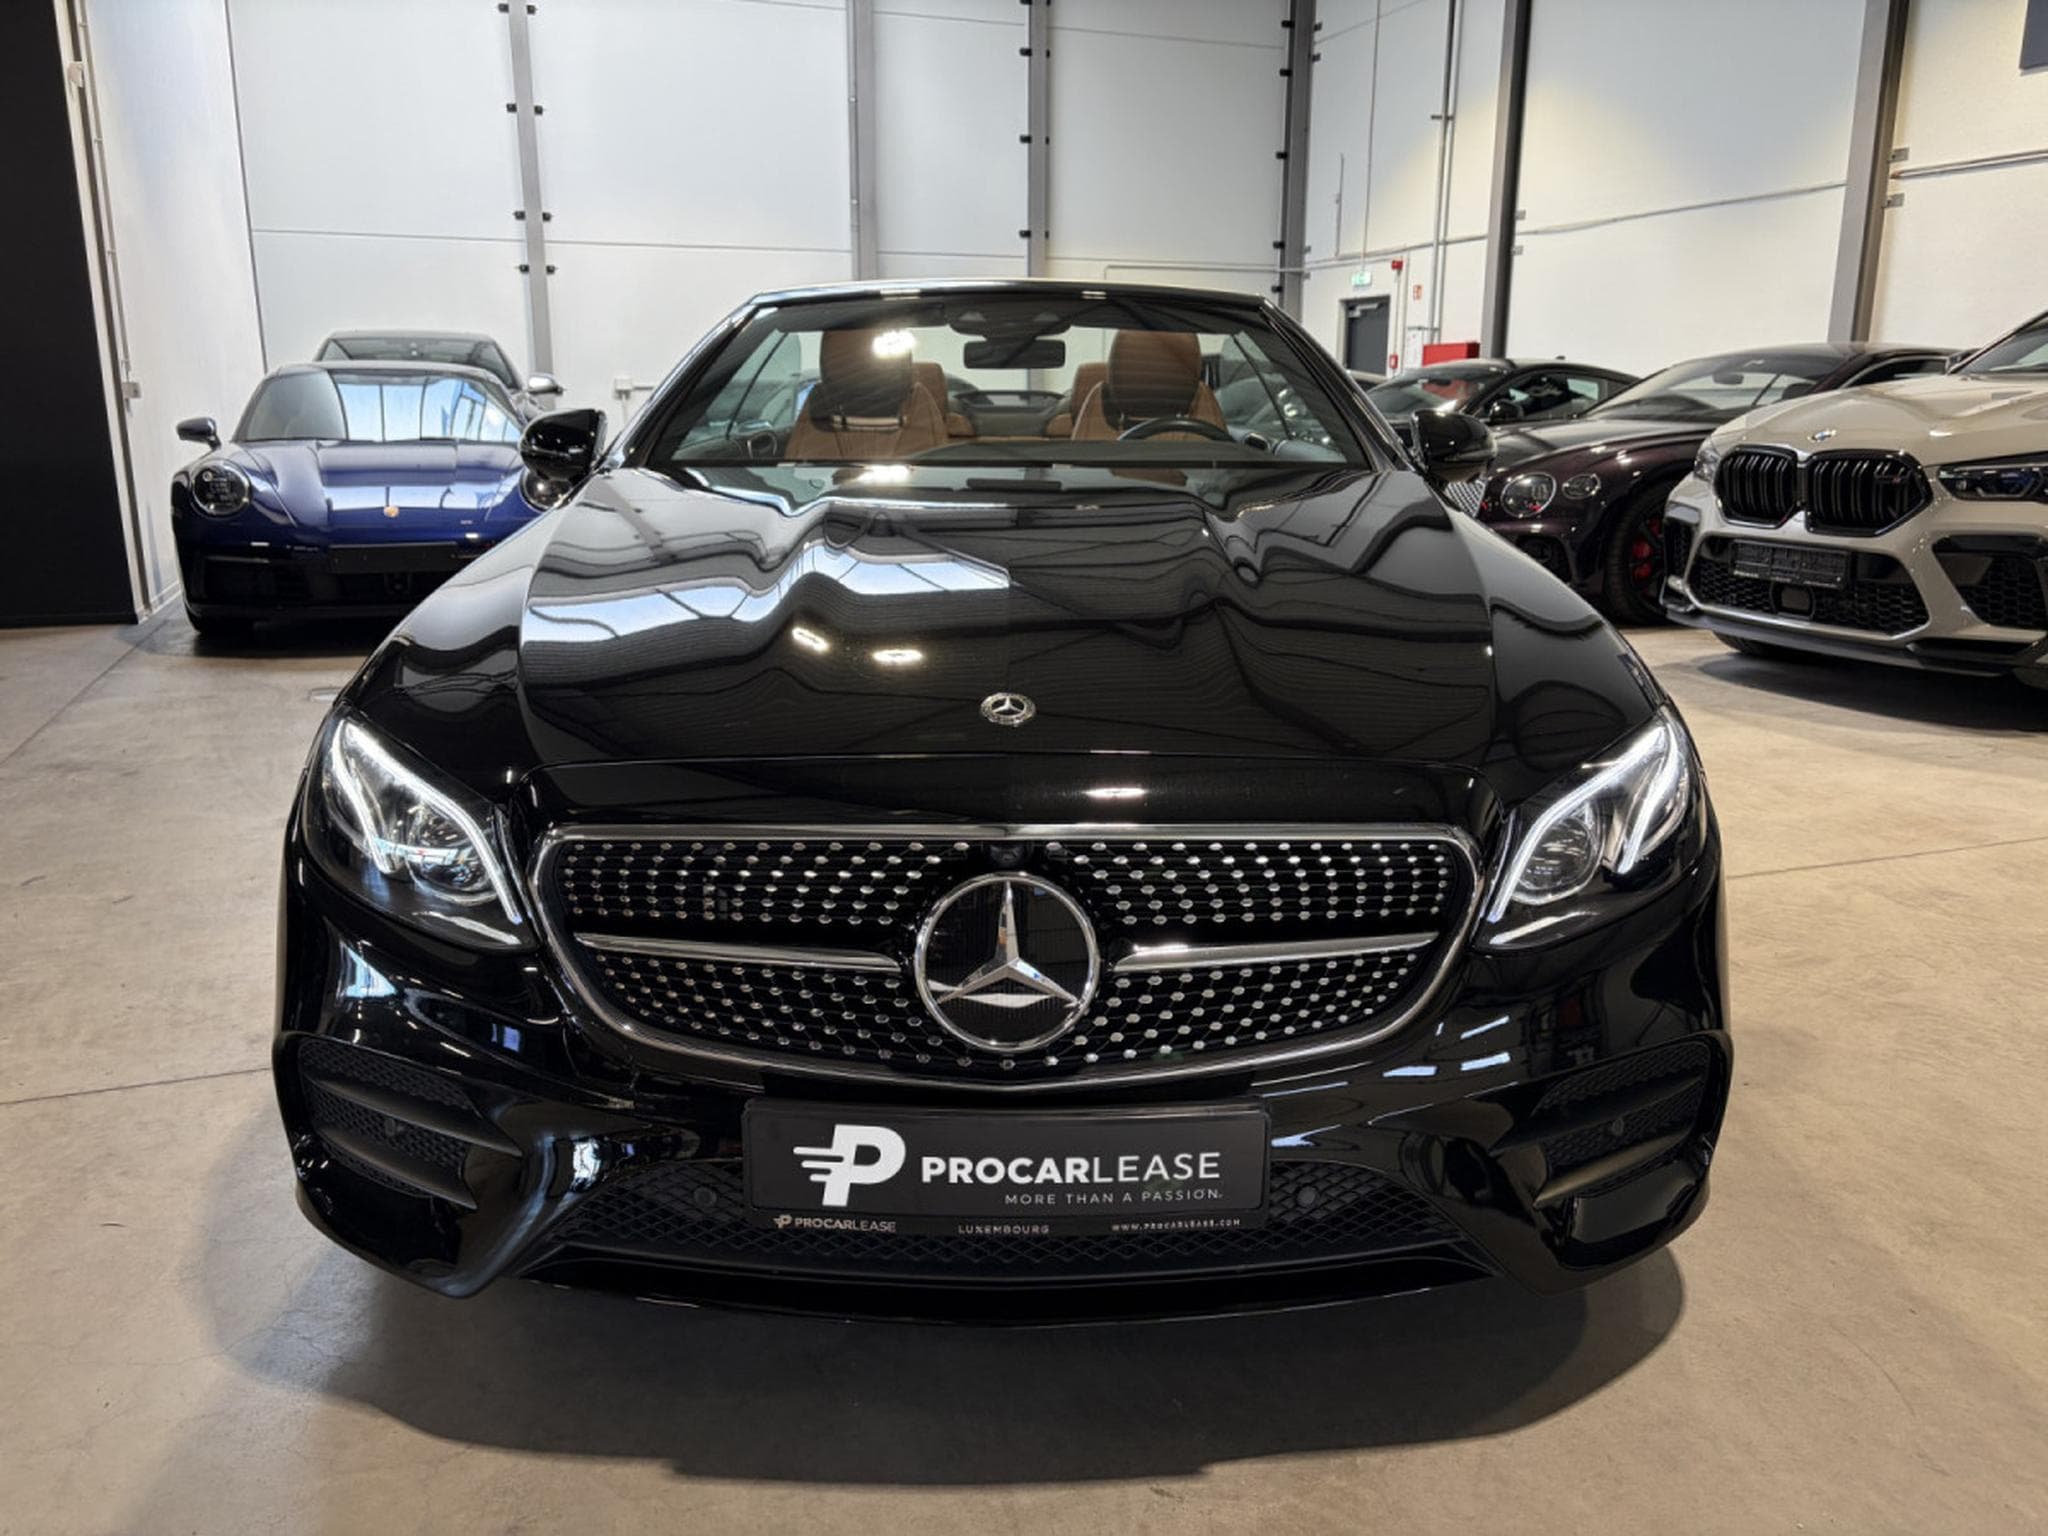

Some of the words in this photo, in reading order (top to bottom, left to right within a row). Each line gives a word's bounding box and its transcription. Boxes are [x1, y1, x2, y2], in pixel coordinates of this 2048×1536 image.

[921, 1151, 1221, 1185] PROCARLEASE
[1005, 1193, 1056, 1205] MORE
[1066, 1192, 1114, 1204] THAN
[1122, 1192, 1133, 1202] A
[794, 1216, 896, 1233] PROCARLEASE
[958, 1224, 1050, 1235] LUXEMBOURG
